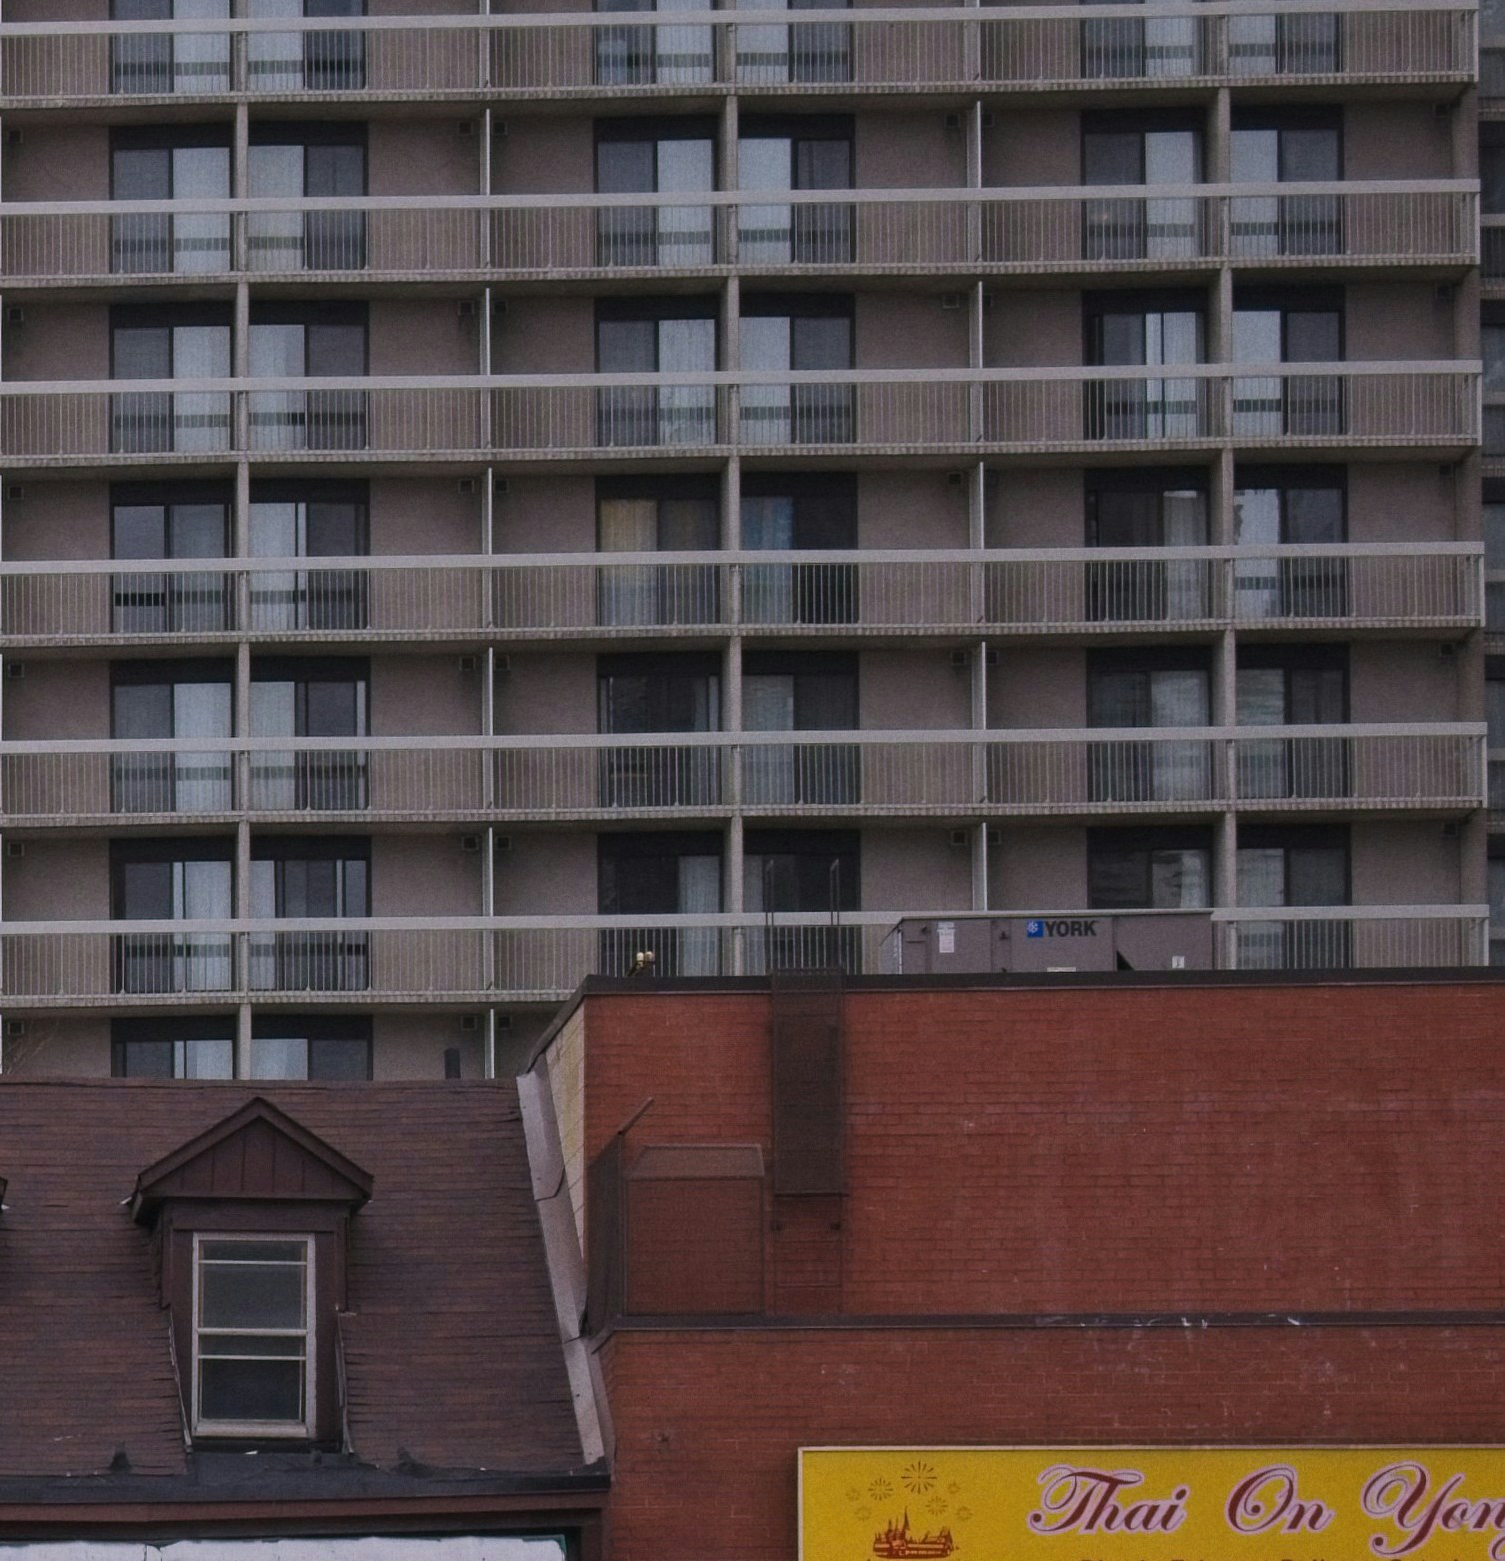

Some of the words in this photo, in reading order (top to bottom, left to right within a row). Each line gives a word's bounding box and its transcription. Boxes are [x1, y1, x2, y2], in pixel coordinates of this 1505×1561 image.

[1046, 920, 1096, 937] YORK
[1029, 1463, 1189, 1535] Thai
[1224, 1463, 1335, 1535] On
